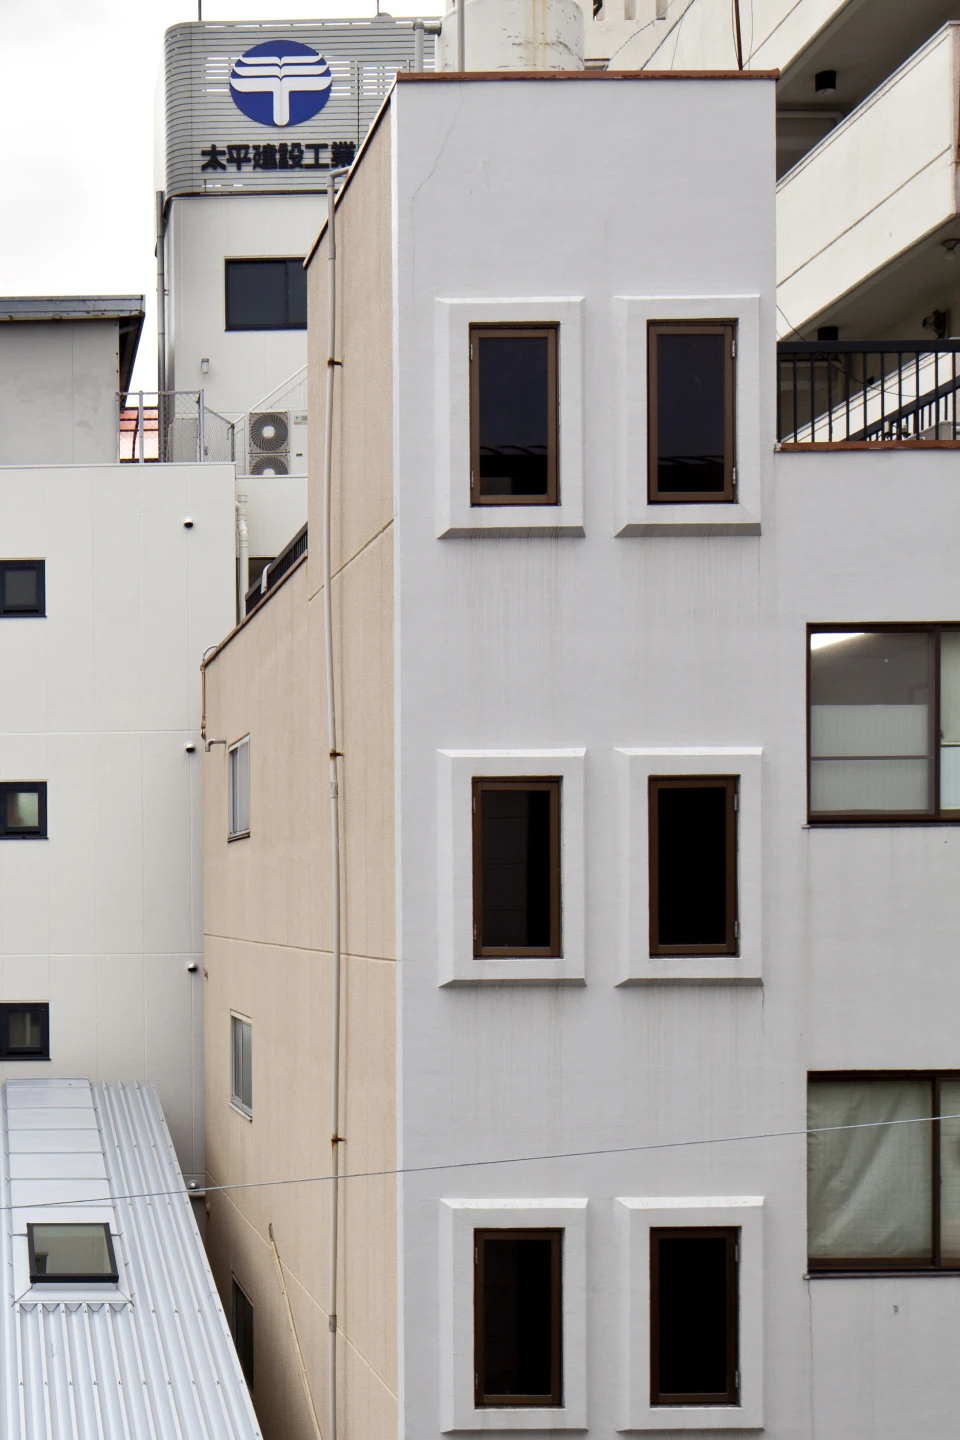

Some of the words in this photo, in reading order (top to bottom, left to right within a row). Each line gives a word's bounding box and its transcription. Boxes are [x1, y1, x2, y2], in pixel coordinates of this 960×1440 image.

[201, 141, 356, 171] 太平建設工業
